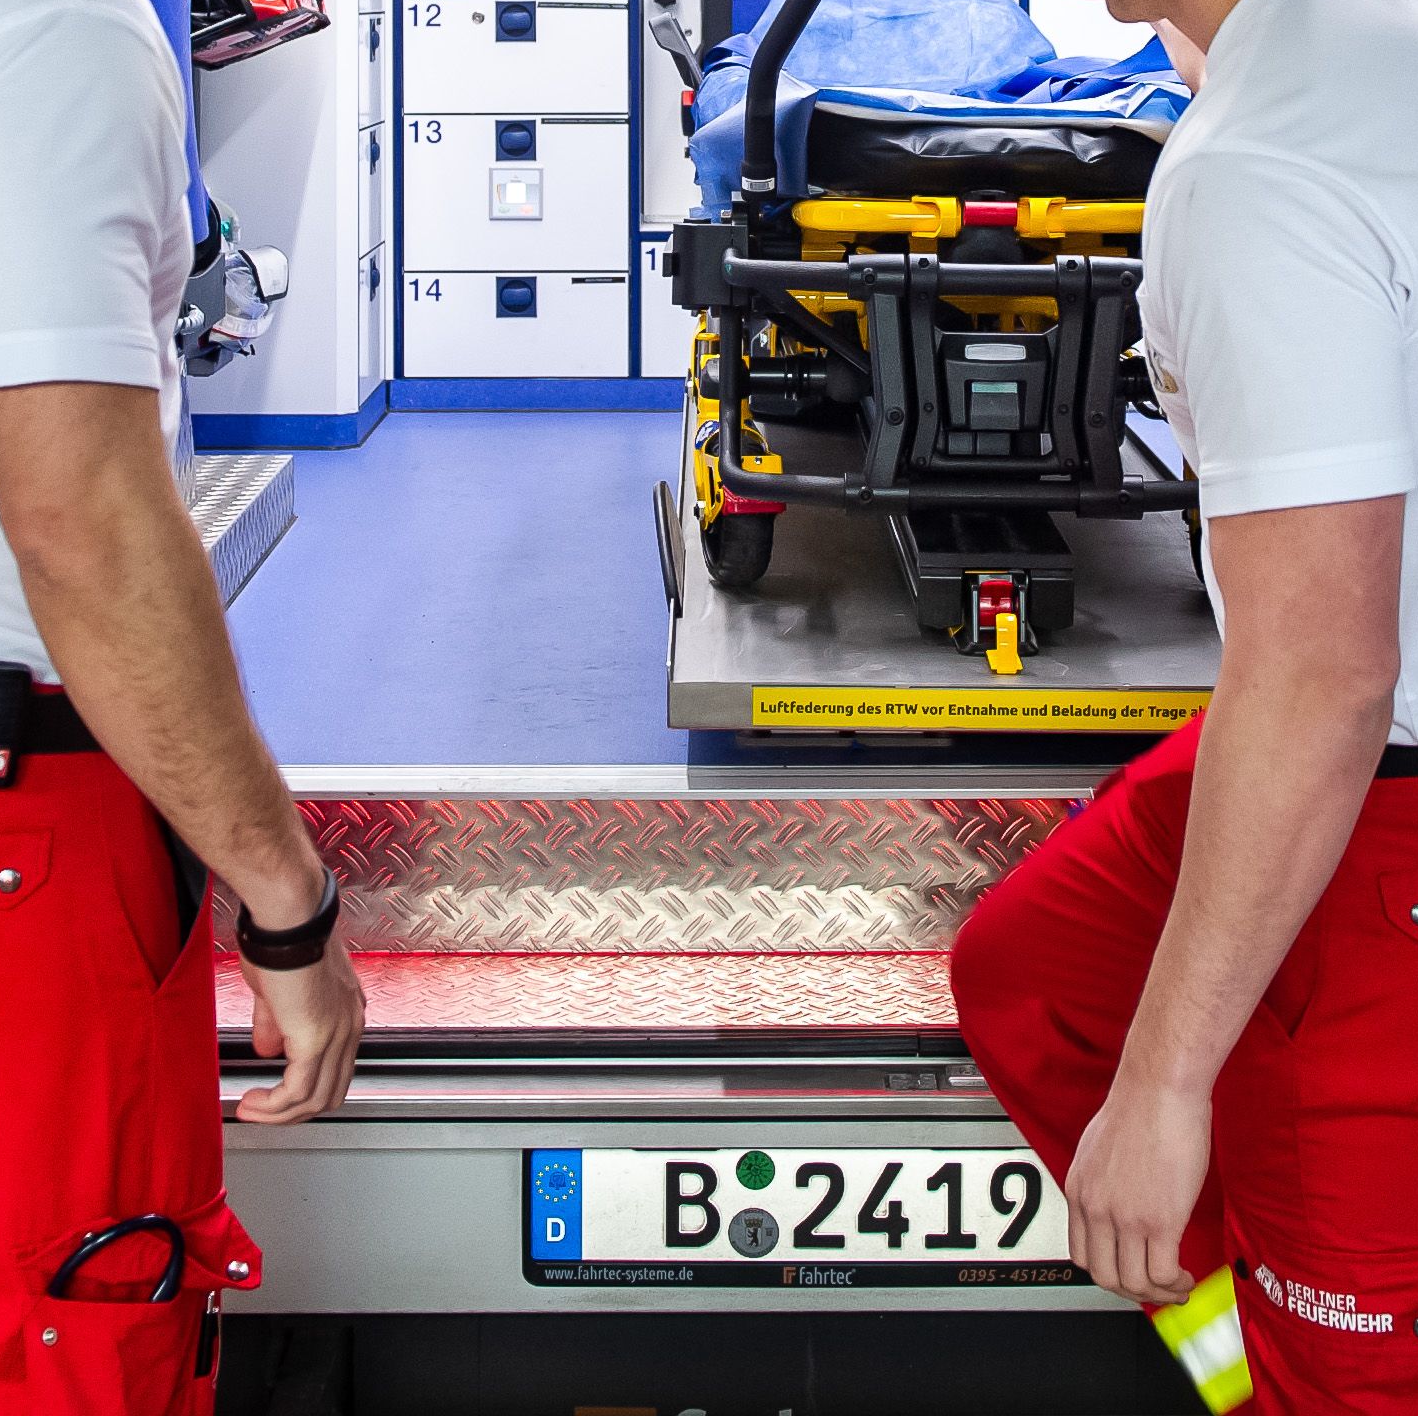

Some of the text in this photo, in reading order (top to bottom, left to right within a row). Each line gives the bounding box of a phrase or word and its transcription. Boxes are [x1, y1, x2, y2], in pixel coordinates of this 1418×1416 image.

[407, 3, 442, 27] 12
[408, 120, 442, 144] 13
[645, 247, 657, 271] 1
[408, 278, 442, 302] 14
[760, 701, 854, 717] Luftfederung
[857, 701, 882, 715] des
[885, 703, 918, 715] RTW
[921, 705, 945, 716] vor
[948, 703, 1018, 716] Entnahme
[1022, 703, 1048, 717] und
[1051, 704, 1117, 720] Beladung
[1121, 705, 1144, 718] der
[1148, 706, 1186, 720] Trage
[665, 1161, 721, 1248] B
[792, 1161, 1045, 1251] 2419
[546, 1217, 567, 1243] D
[544, 1266, 694, 1283] www.fahrtec-systeme.de
[958, 1268, 997, 1282] 0395
[1009, 1268, 1073, 1282] 45126-0
[1286, 1279, 1356, 1312] BERLINER
[1287, 1295, 1394, 1334] FEUERWEHR
